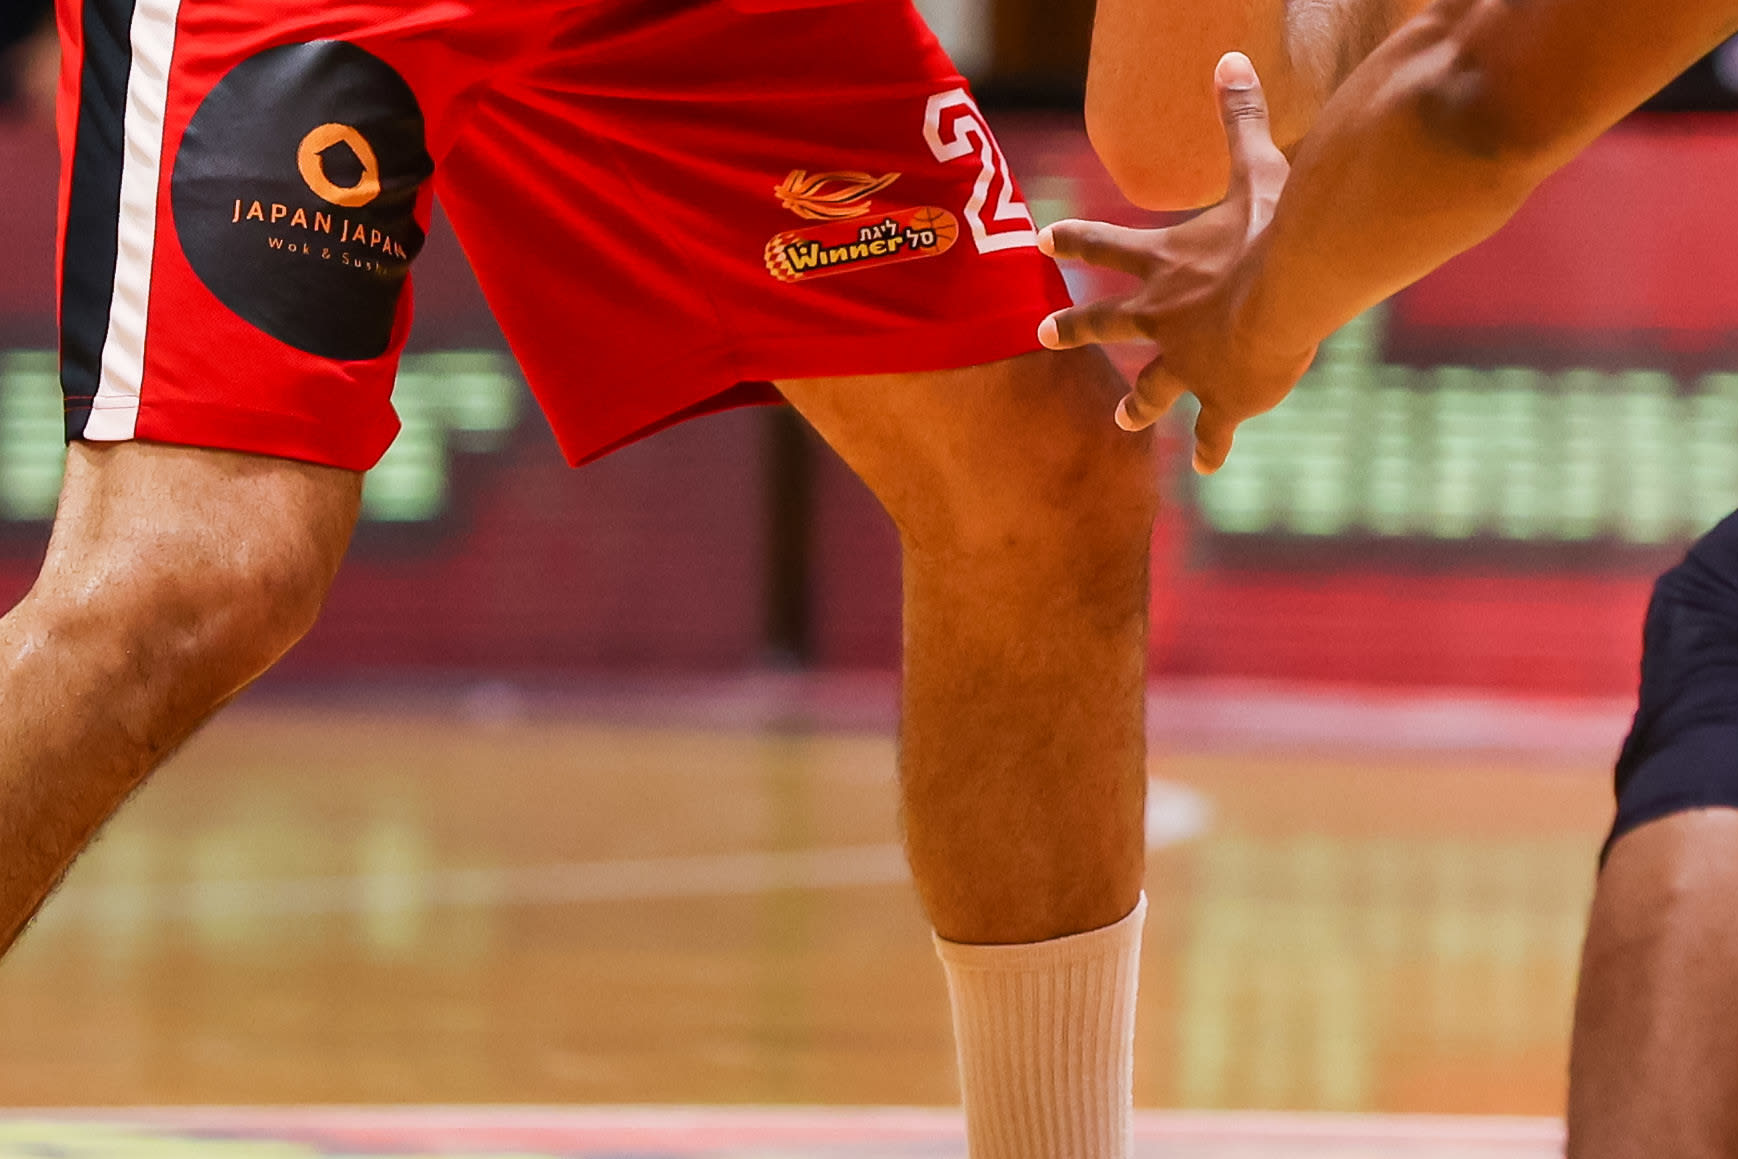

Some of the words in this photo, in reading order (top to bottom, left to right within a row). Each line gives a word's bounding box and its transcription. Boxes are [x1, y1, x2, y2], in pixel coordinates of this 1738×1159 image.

[232, 199, 332, 234] JAPAN
[860, 219, 897, 241] ליגת
[906, 231, 934, 248] סל
[268, 236, 310, 255] Wok
[321, 247, 331, 260] &
[787, 236, 903, 270] Winner
